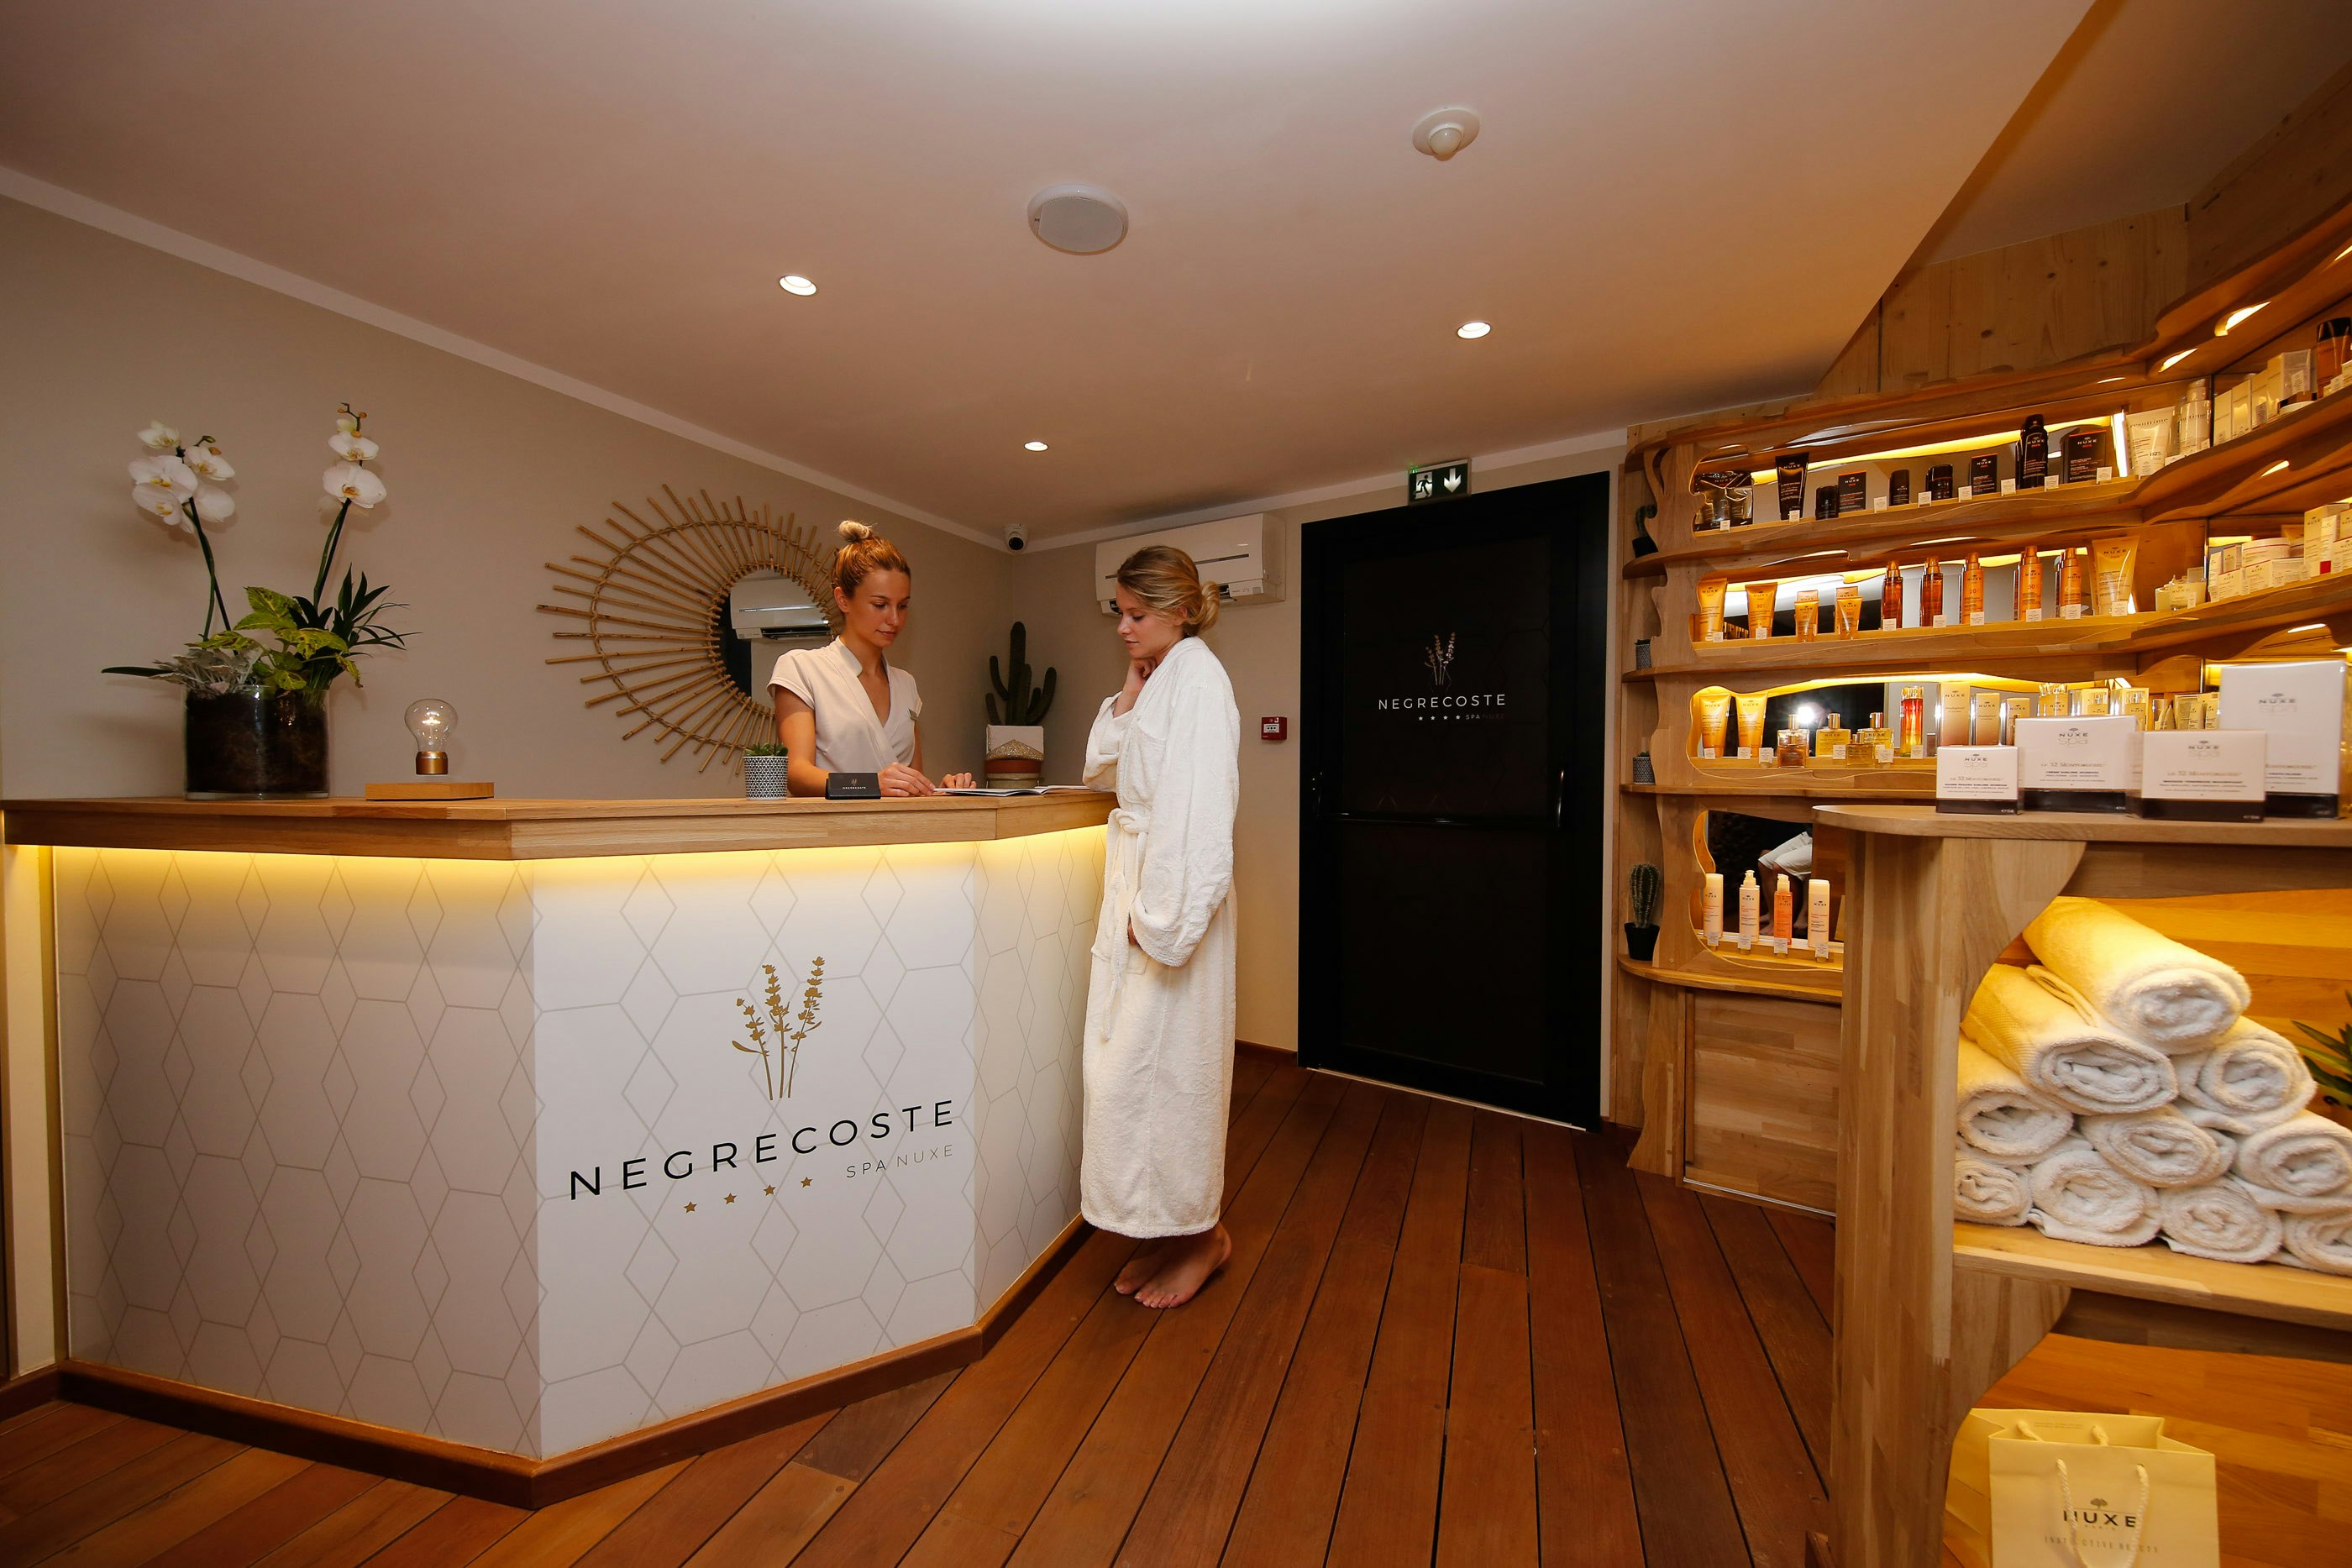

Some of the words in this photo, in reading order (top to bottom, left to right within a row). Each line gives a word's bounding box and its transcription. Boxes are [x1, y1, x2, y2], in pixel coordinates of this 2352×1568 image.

[1378, 694, 1506, 711] NEGRECOSTE
[2058, 737, 2089, 747] spa
[570, 1099, 953, 1201] NEGRECOSTE
[846, 1158, 887, 1178] SPA
[896, 1143, 954, 1168] NUXE
